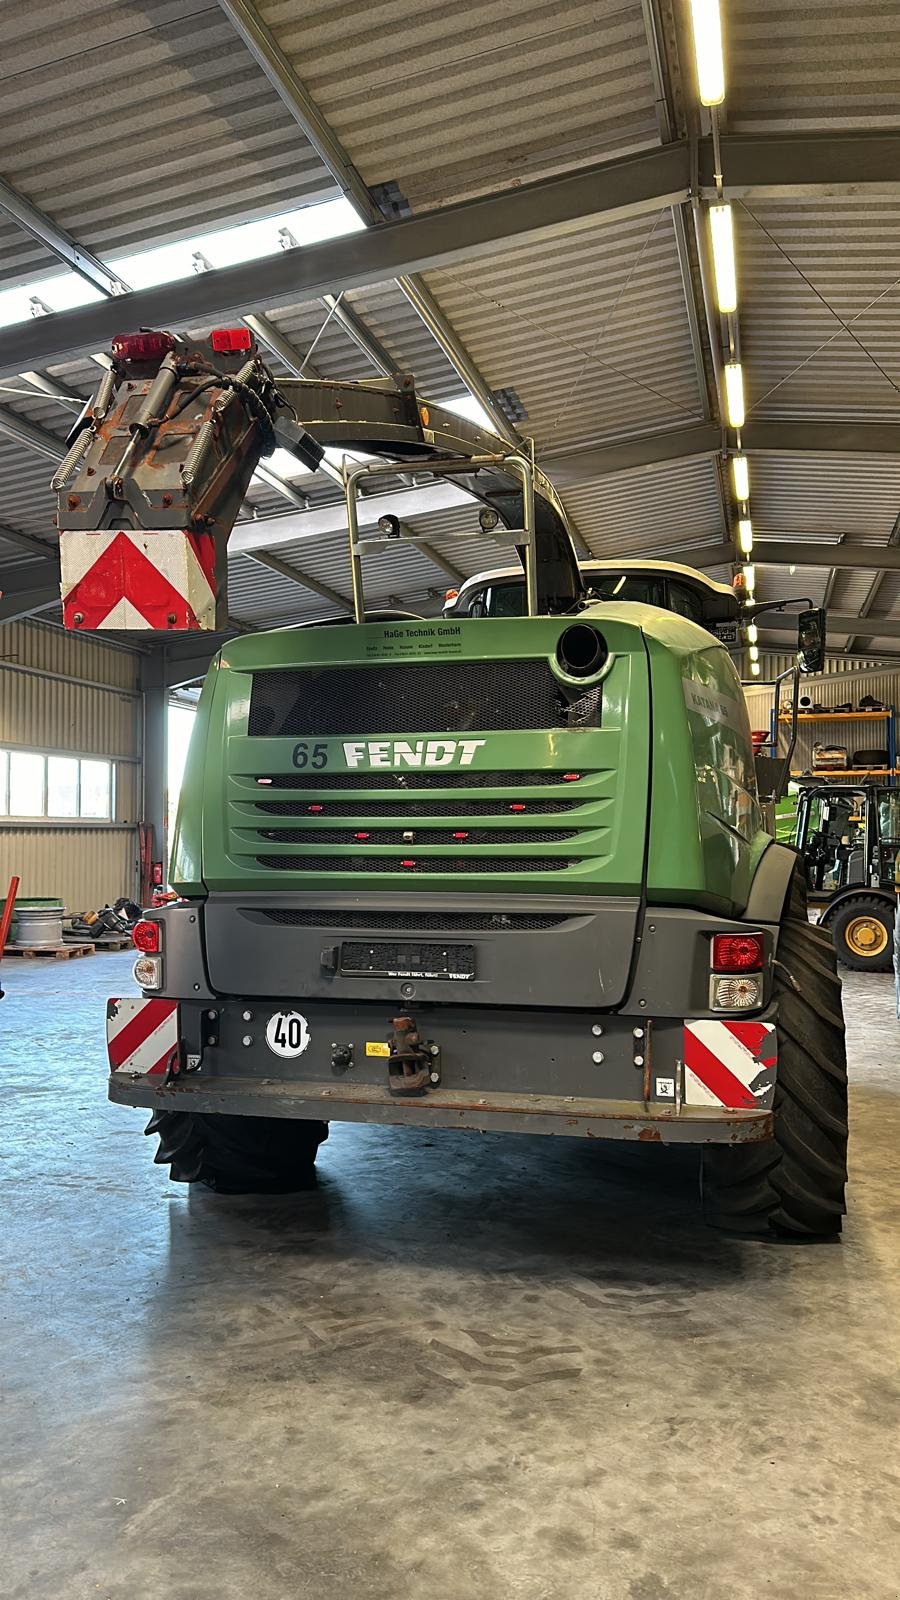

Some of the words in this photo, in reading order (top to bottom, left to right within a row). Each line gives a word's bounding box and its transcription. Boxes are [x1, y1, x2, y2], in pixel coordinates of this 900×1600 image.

[383, 629, 404, 638] HaGe
[406, 628, 436, 637] Technik
[437, 627, 461, 636] GmbH
[292, 742, 328, 769] 65
[342, 739, 487, 768] FENDT
[274, 1017, 301, 1049] 40
